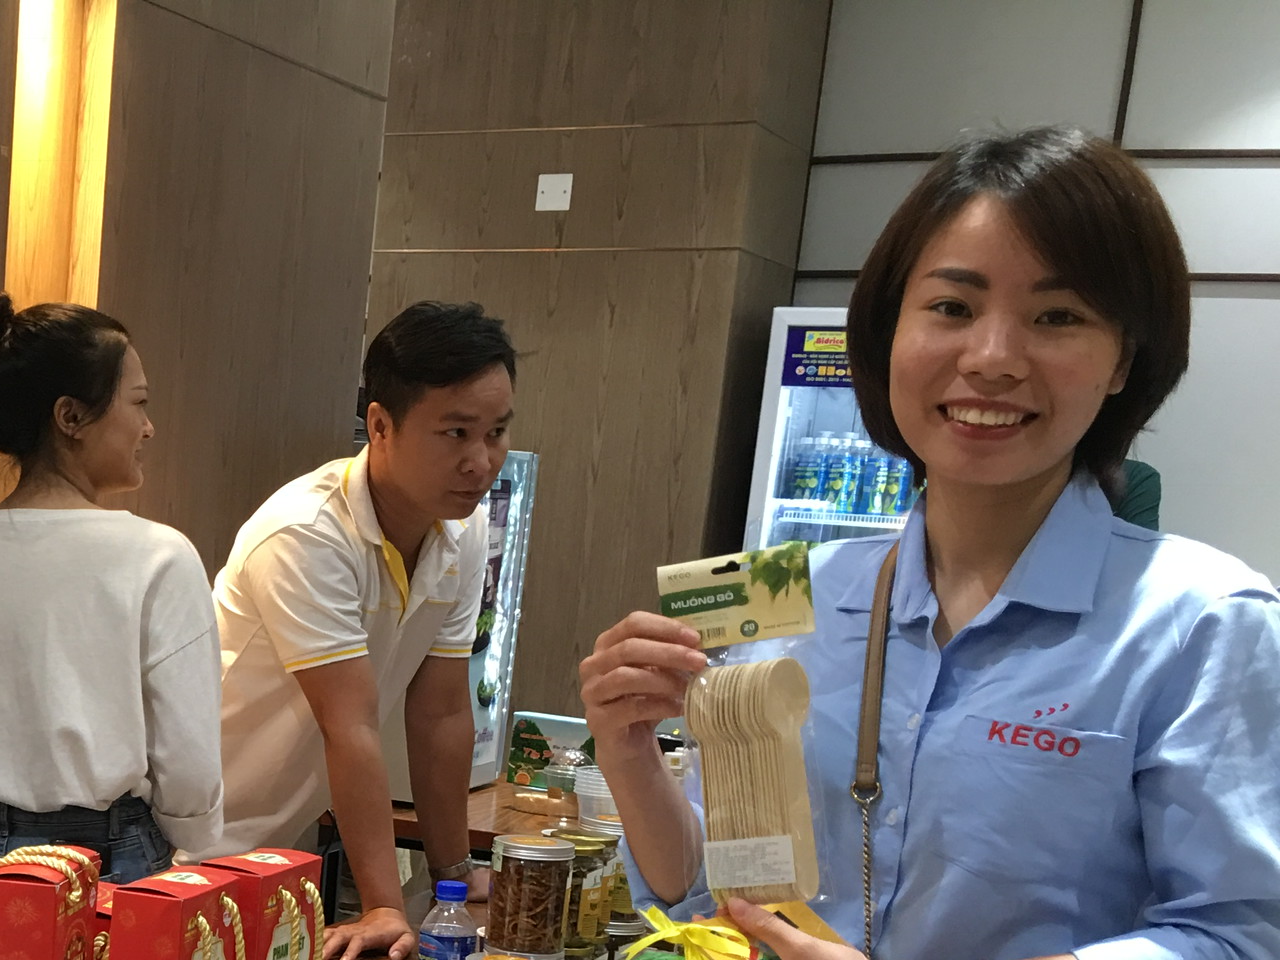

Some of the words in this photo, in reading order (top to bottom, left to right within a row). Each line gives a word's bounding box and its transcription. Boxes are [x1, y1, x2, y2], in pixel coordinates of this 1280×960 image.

[815, 337, 844, 345] Bidrico
[667, 572, 691, 582] KEGO
[743, 623, 755, 632] 20
[988, 720, 1081, 757] KEGO
